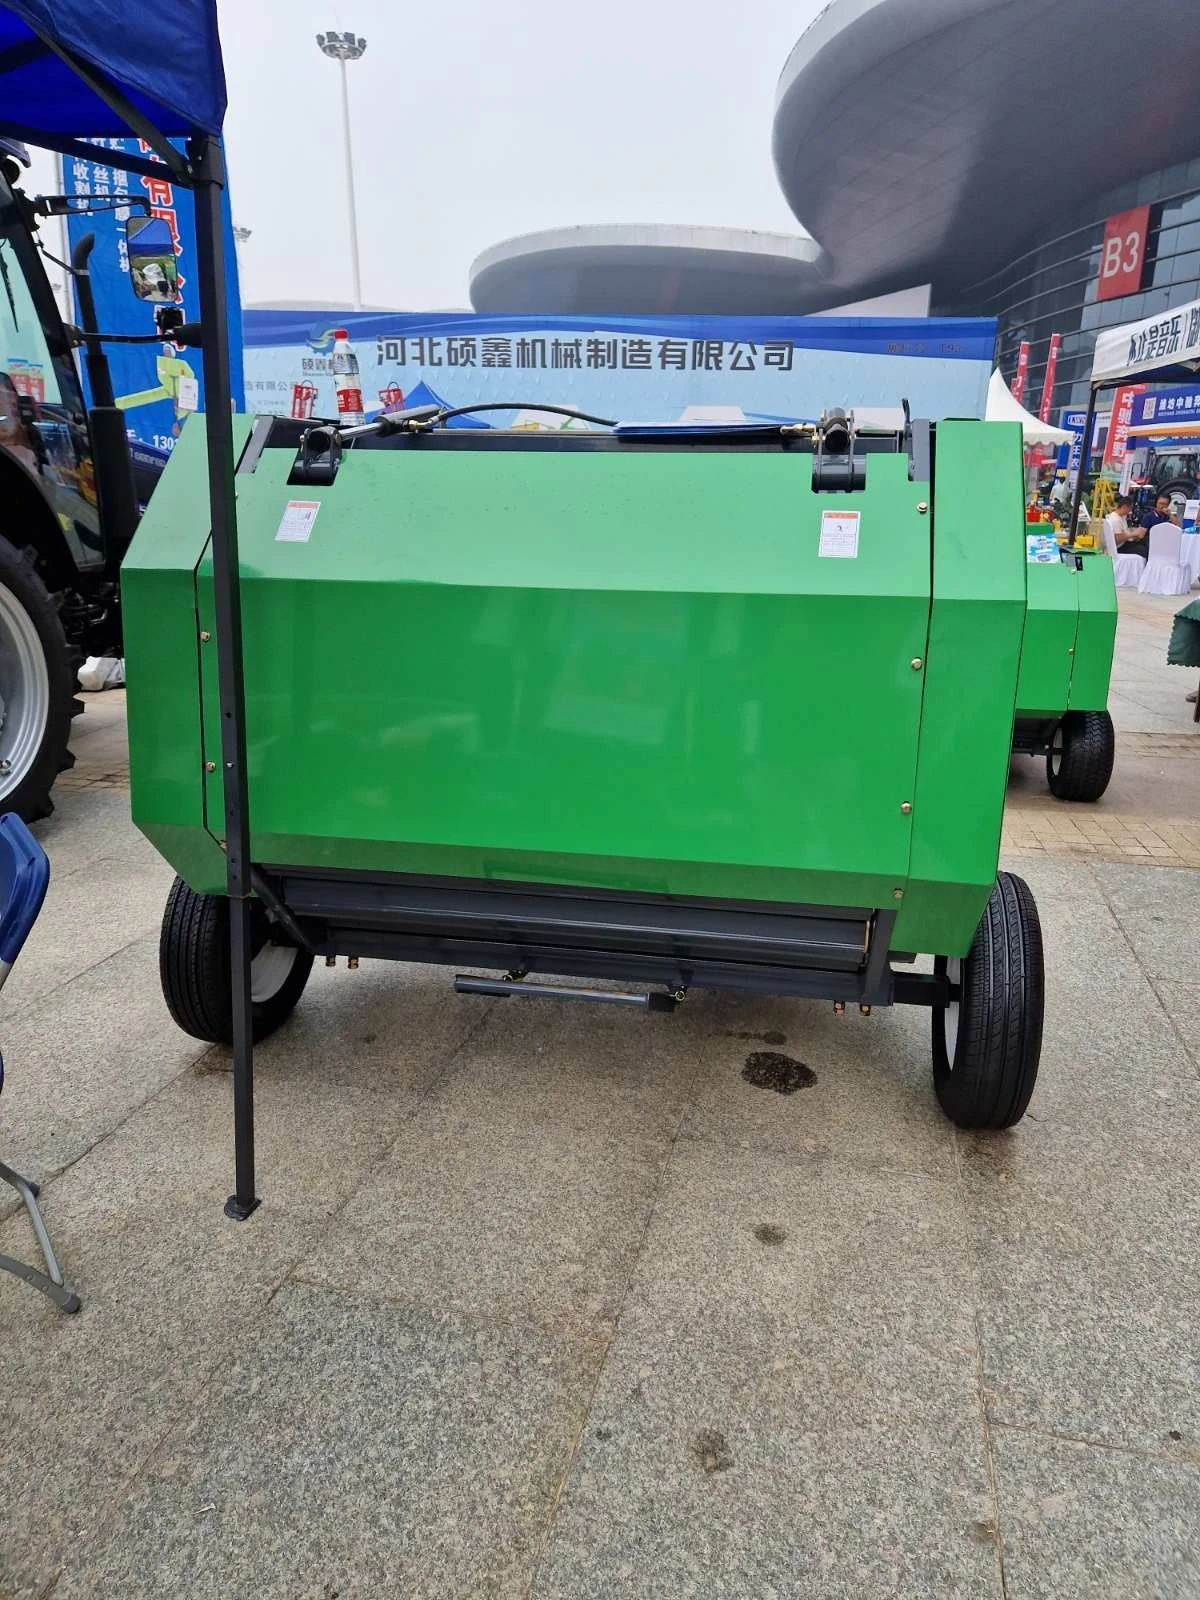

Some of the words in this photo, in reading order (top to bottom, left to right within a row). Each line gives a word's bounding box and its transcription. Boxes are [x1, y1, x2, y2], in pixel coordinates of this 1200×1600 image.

[1102, 231, 1142, 280] B3
[376, 335, 794, 371] 河北硕鑫机械制造有限公司
[152, 434, 179, 450] 130
